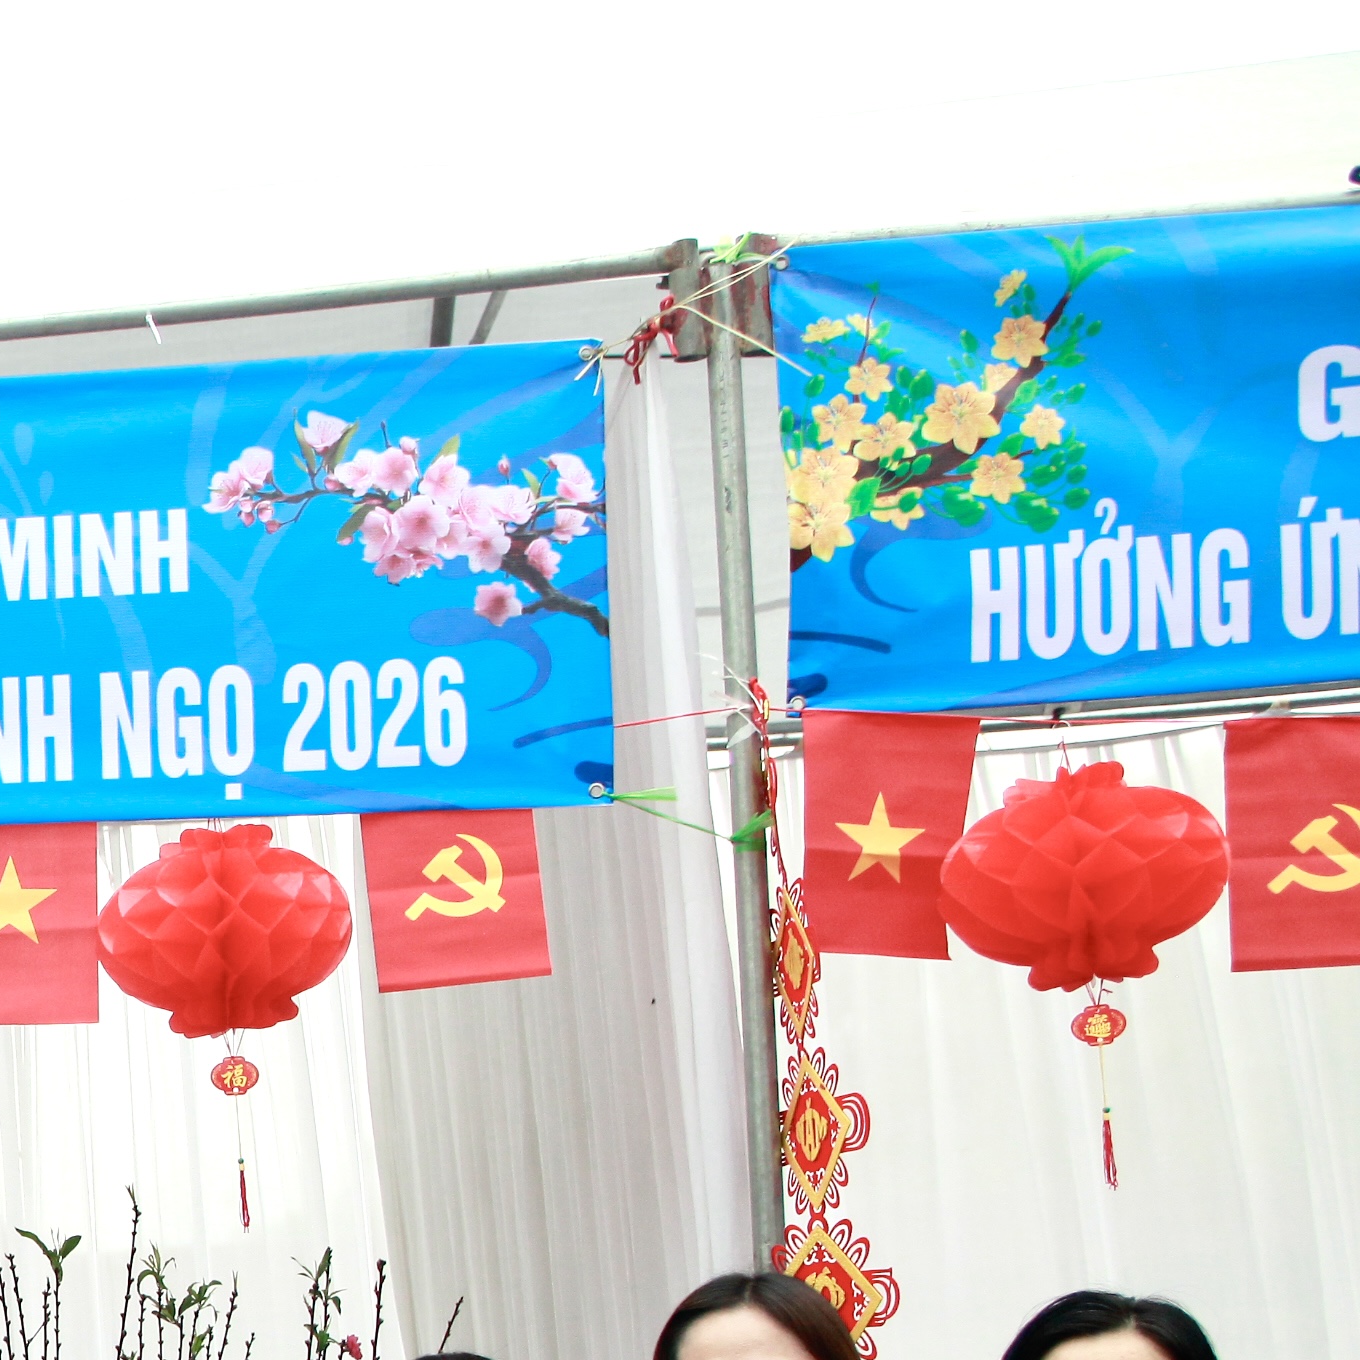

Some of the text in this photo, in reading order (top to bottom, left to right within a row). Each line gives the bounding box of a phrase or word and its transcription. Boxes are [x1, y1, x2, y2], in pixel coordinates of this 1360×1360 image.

[971, 499, 1250, 662] HƯỞNG
[100, 664, 254, 800] NGỌ
[284, 656, 467, 772] 2026
[221, 1063, 248, 1089] 福
